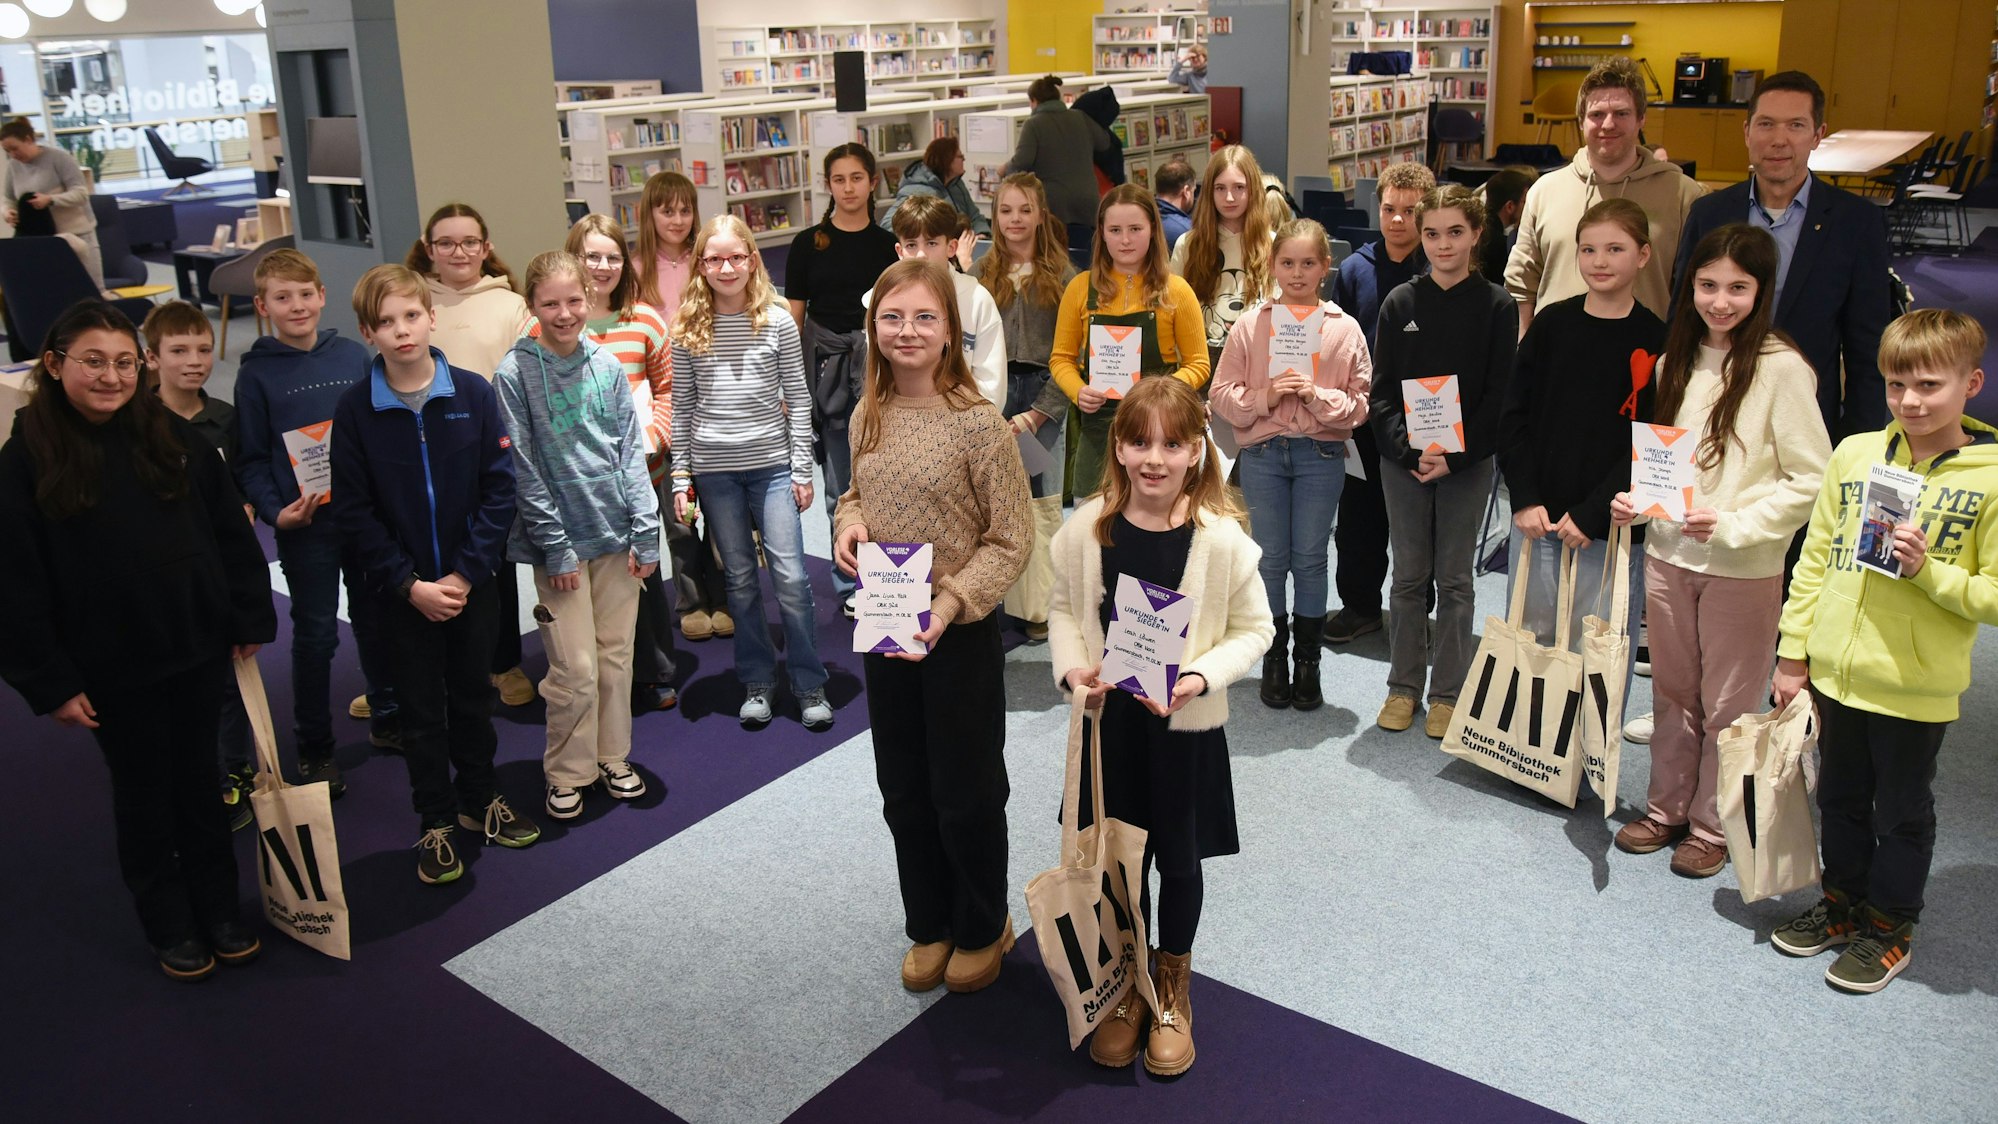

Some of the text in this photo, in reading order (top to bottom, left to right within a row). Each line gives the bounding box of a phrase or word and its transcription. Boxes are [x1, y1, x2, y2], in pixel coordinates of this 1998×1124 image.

[1645, 447, 1673, 456] URKUNDE
[1931, 486, 1986, 517] ME
[1124, 605, 1159, 623] URKUNDE
[1461, 735, 1550, 783] Gummersbach
[1462, 725, 1495, 746] Neue
[1498, 741, 1562, 777] Bibliothek
